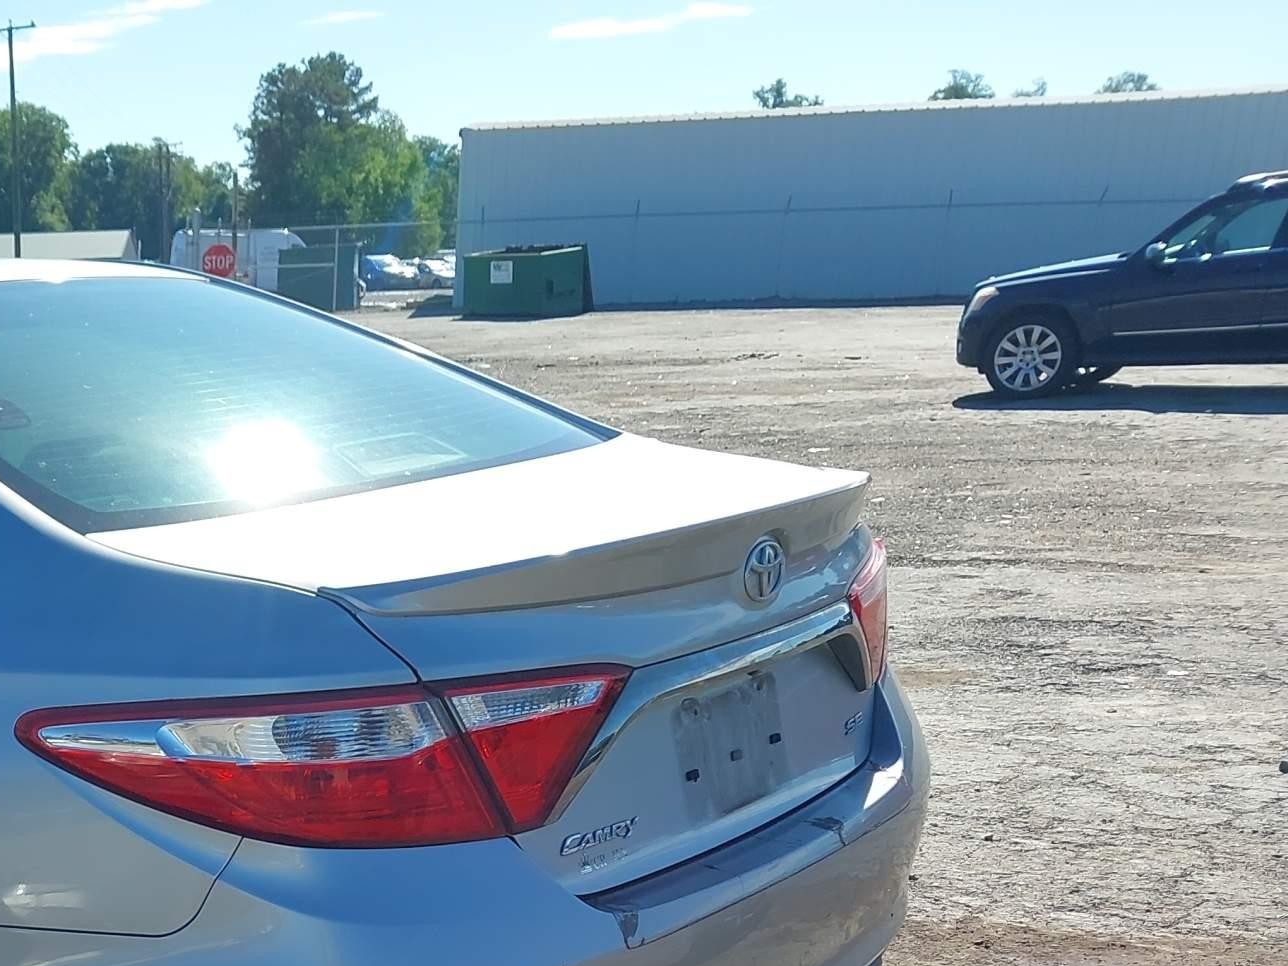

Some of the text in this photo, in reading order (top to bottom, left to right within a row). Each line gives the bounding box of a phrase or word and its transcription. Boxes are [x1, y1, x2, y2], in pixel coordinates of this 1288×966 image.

[203, 255, 234, 270] STOP
[844, 711, 864, 736] SE
[560, 816, 639, 856] CAMRY
